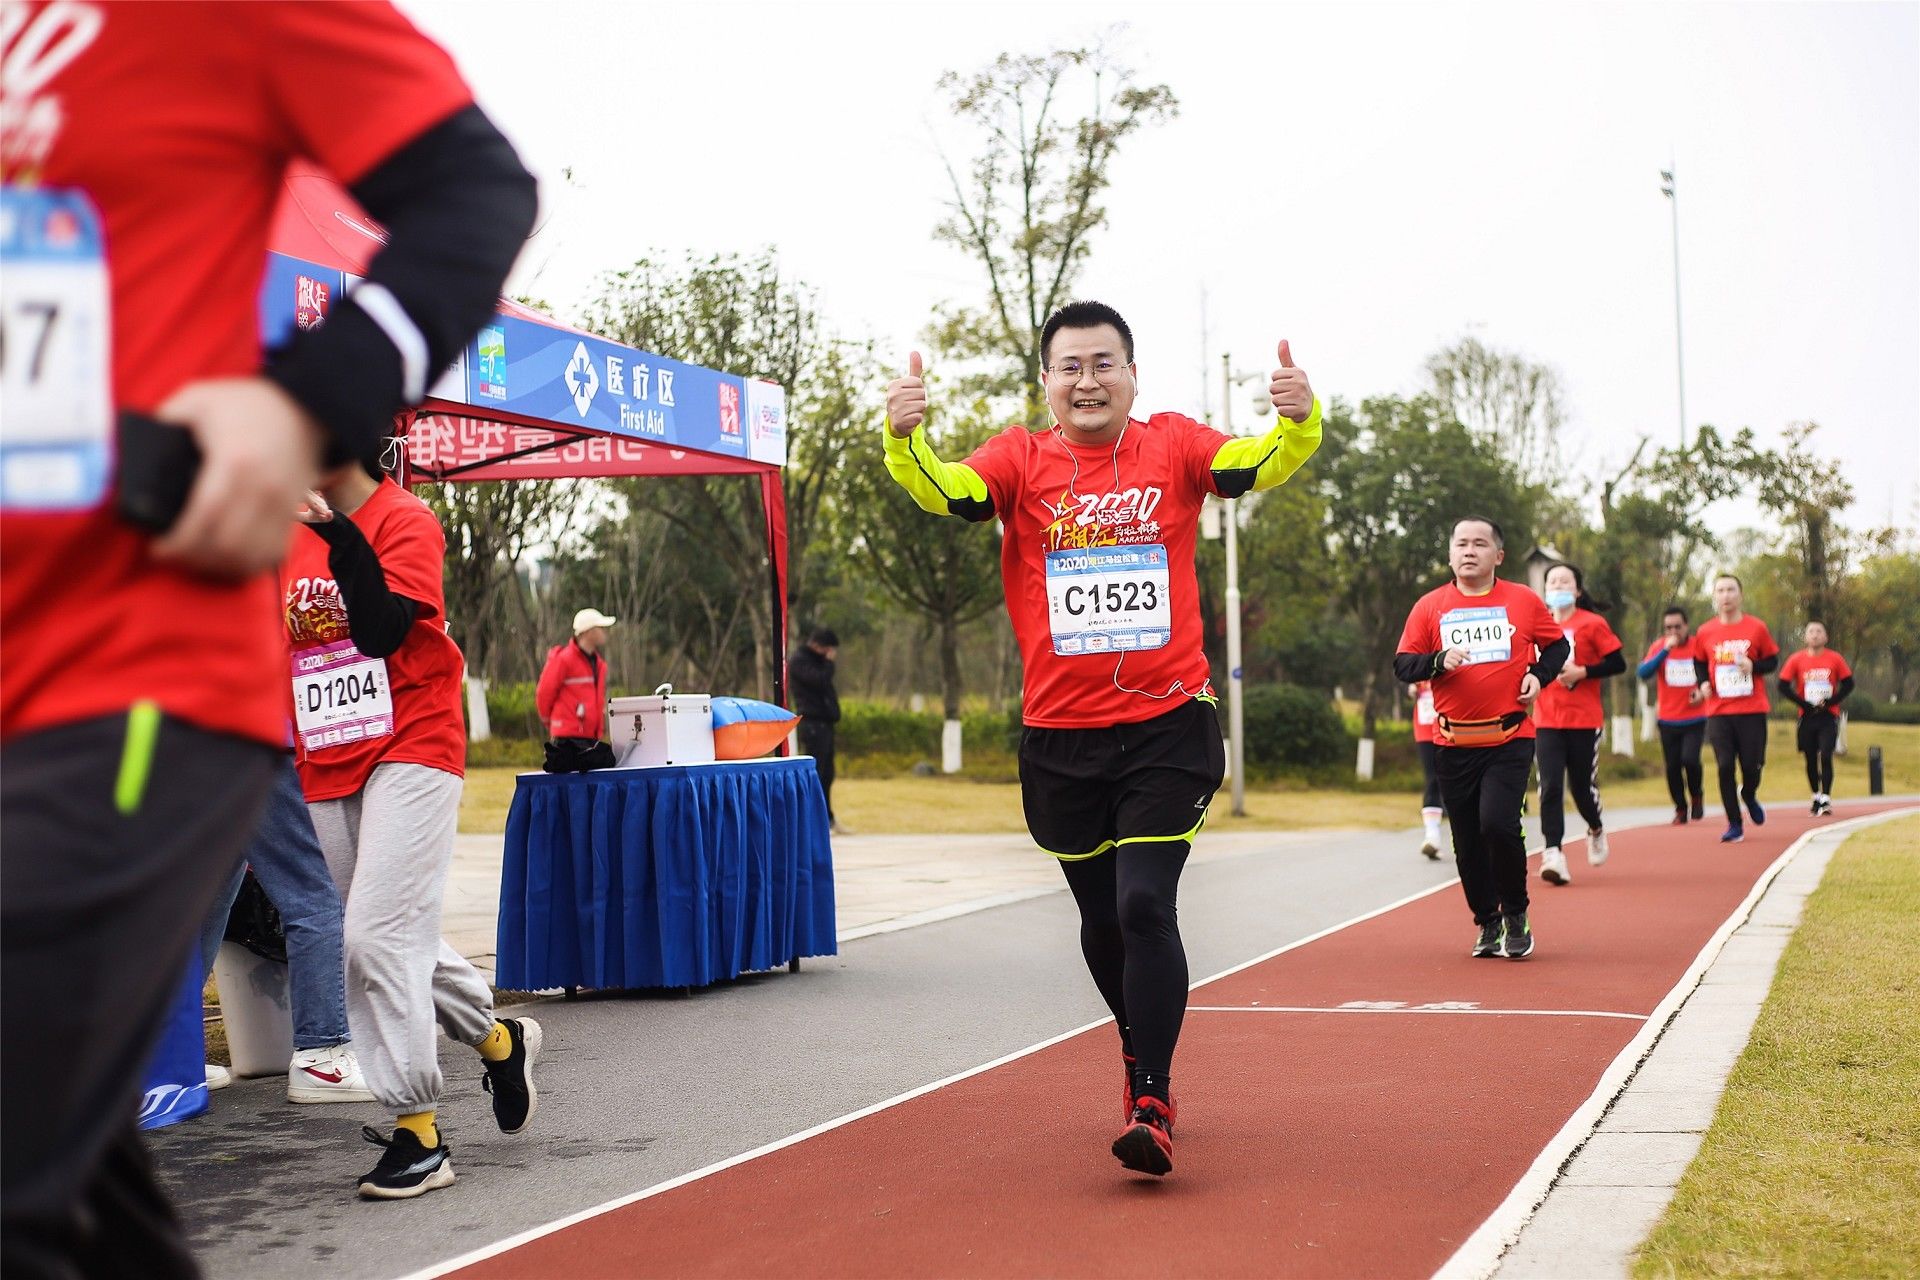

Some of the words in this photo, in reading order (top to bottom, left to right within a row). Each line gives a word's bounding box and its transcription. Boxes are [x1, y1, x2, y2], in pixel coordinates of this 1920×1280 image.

[606, 355, 676, 408] 医疗区
[620, 403, 645, 432] First
[647, 410, 665, 436] Aid
[1065, 581, 1158, 616] C1523
[1451, 625, 1502, 645] C1410
[307, 671, 378, 713] D1204
